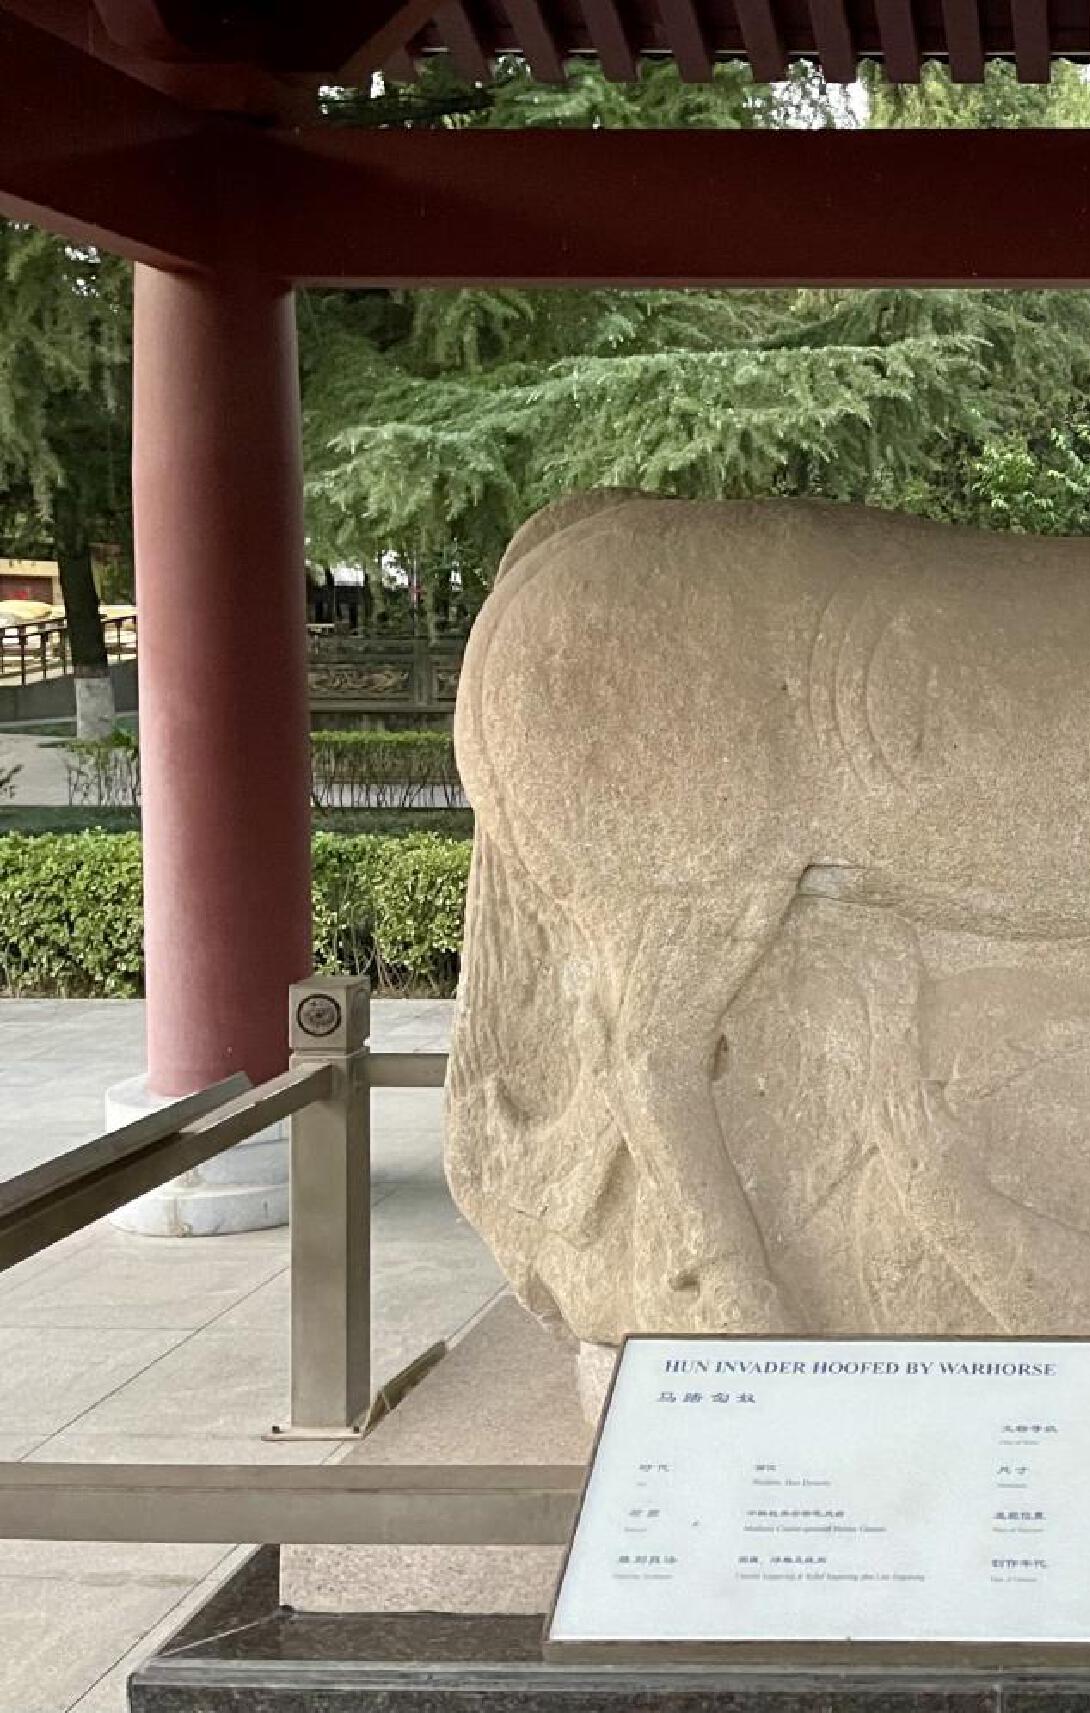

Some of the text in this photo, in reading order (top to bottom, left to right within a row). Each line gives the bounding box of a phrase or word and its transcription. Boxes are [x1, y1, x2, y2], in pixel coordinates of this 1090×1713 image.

[665, 1360, 1057, 1376] HUN INVADER HOOFED BY WARHORSE
